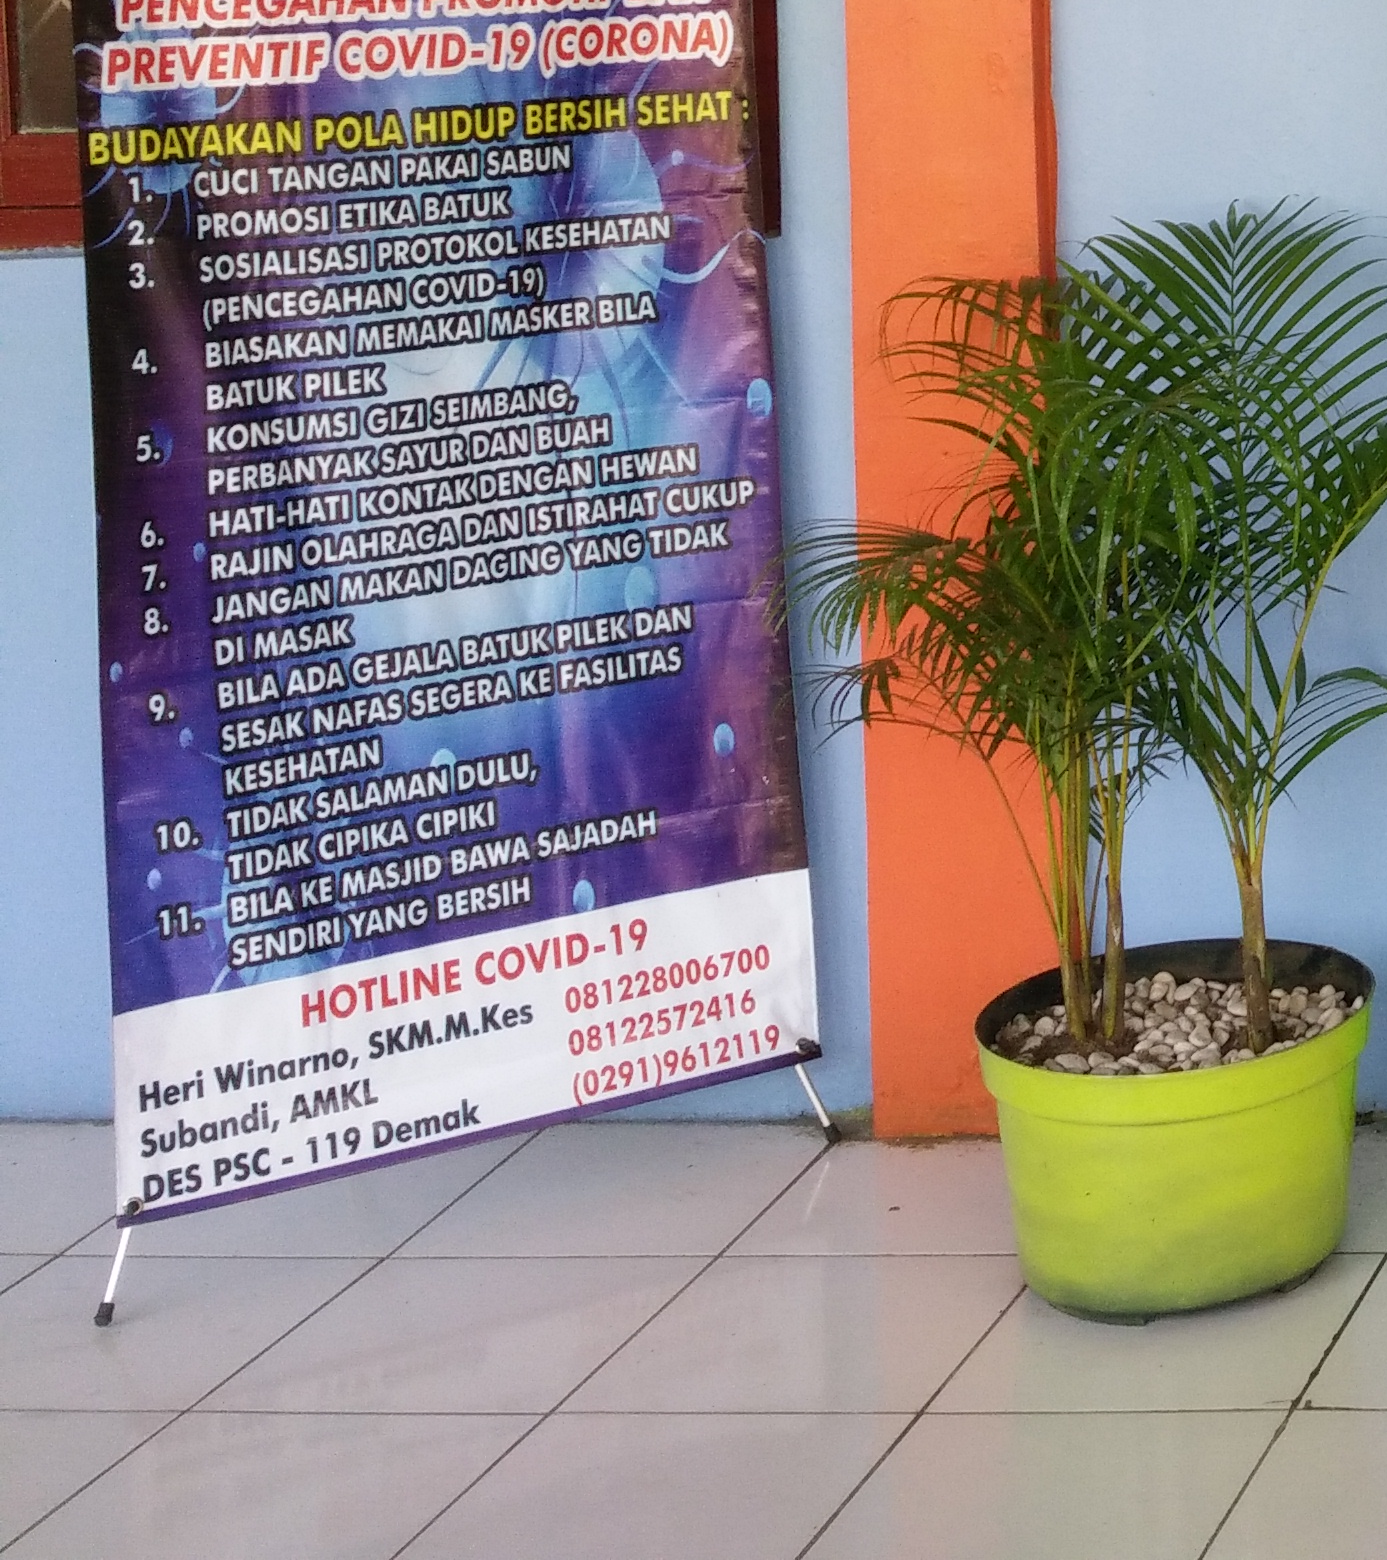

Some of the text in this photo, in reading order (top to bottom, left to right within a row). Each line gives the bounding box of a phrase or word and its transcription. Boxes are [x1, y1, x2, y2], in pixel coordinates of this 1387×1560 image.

[106, 18, 733, 86] PREVENTIF COVID-19 (CORONA)
[89, 121, 301, 165] BUDAYAKAN
[316, 116, 402, 151] POLA
[414, 106, 515, 145] HIDUP
[525, 99, 627, 136] BERSIH
[637, 92, 730, 127] SEHAT
[129, 146, 570, 203] 1. CUCI TANGAN PAKAI SABUN
[128, 190, 511, 245] 2. PROMOSI ETIKA BATUK
[129, 215, 670, 289] 3. SOSIALISASI PROTOKOL KESEHATAN
[131, 295, 655, 374] 4. BIASAKAN MEMAKAI MASKER BILA
[203, 268, 545, 329] (PENCEGAHAN COVID-19)
[136, 384, 578, 462] 5. KONSUMSI GIZI SEIMBANG,
[206, 367, 385, 411] BATUK PILEK
[208, 419, 611, 494] PERBANYAK SAYUR DAN BUAH
[141, 448, 697, 548] 6. HATI-HATI KONTAK DENGAN HEWAN
[142, 481, 755, 591] 7. RAJIN OLAHRAGA DAN ISTIRAHAT CUKUP
[144, 523, 728, 634] 8. JANGAN MAKAN DAGING YANG TIDAK
[149, 606, 694, 721] 9. BILA ADA GEJALA BATUK PILEK DAN
[214, 618, 351, 665] DI MASAK
[221, 647, 683, 753] SESAK NAFAS SEGERA KE FASILITAS
[156, 757, 538, 853] 10. TIDAK SALAMAN DULU,
[224, 742, 380, 795] KESEHATAN
[159, 813, 658, 937] 11. BILA KE MASJID BAWA SAJADAH
[229, 809, 496, 882] TIDAK CIPIKA CIPIKI
[230, 879, 531, 967] SENDIRI YANG BERSIH
[302, 919, 649, 1028] HOTLINE COVID-19
[139, 946, 771, 1113] Heri Winarno, SKM.M.Kes 081228006700
[141, 990, 756, 1158] Subandi, AMKL 08122572416
[142, 1168, 202, 1203] DES
[212, 1154, 271, 1187] PSC
[307, 1129, 361, 1163] 119
[373, 1102, 481, 1151] Demak
[573, 1026, 780, 1106] (0291)9612119
